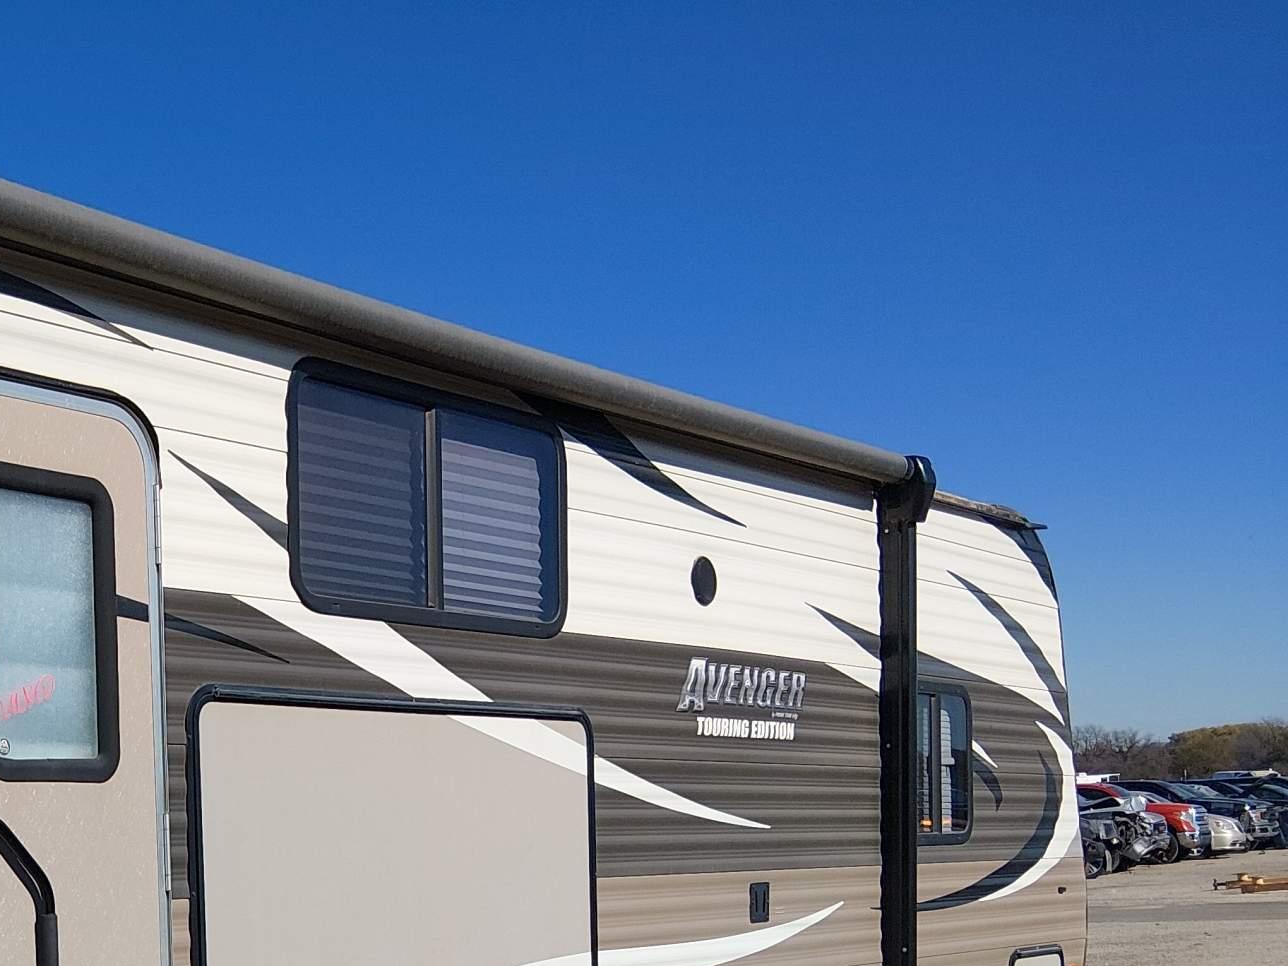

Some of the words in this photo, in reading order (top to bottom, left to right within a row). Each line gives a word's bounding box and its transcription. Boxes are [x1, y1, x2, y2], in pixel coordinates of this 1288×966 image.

[675, 655, 808, 713] AVENGER
[696, 716, 750, 738] TOURING
[750, 719, 795, 741] EDITION
